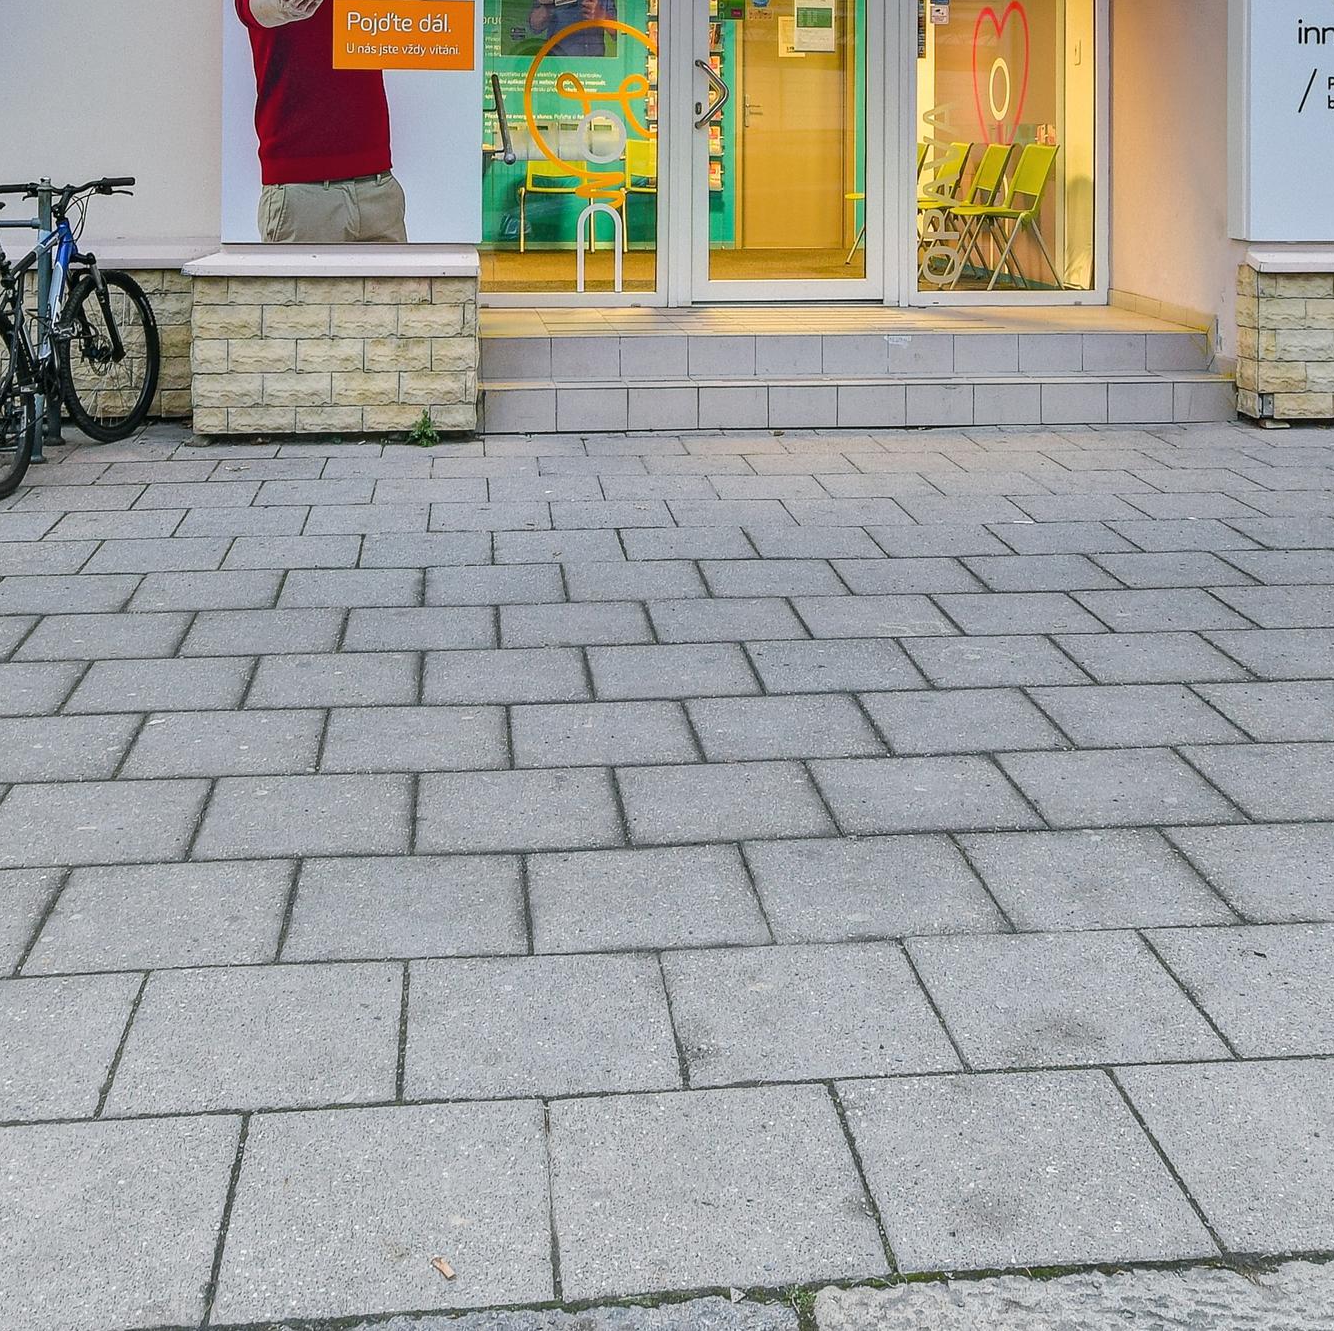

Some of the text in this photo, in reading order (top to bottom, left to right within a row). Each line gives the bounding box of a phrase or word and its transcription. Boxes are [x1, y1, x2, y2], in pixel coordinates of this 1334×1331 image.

[347, 11, 451, 36] Pojďte dál.
[347, 43, 355, 54] U
[357, 42, 377, 54] nás
[378, 43, 399, 56] jste
[402, 43, 427, 57] vždy
[923, 103, 960, 285] OPAVA
